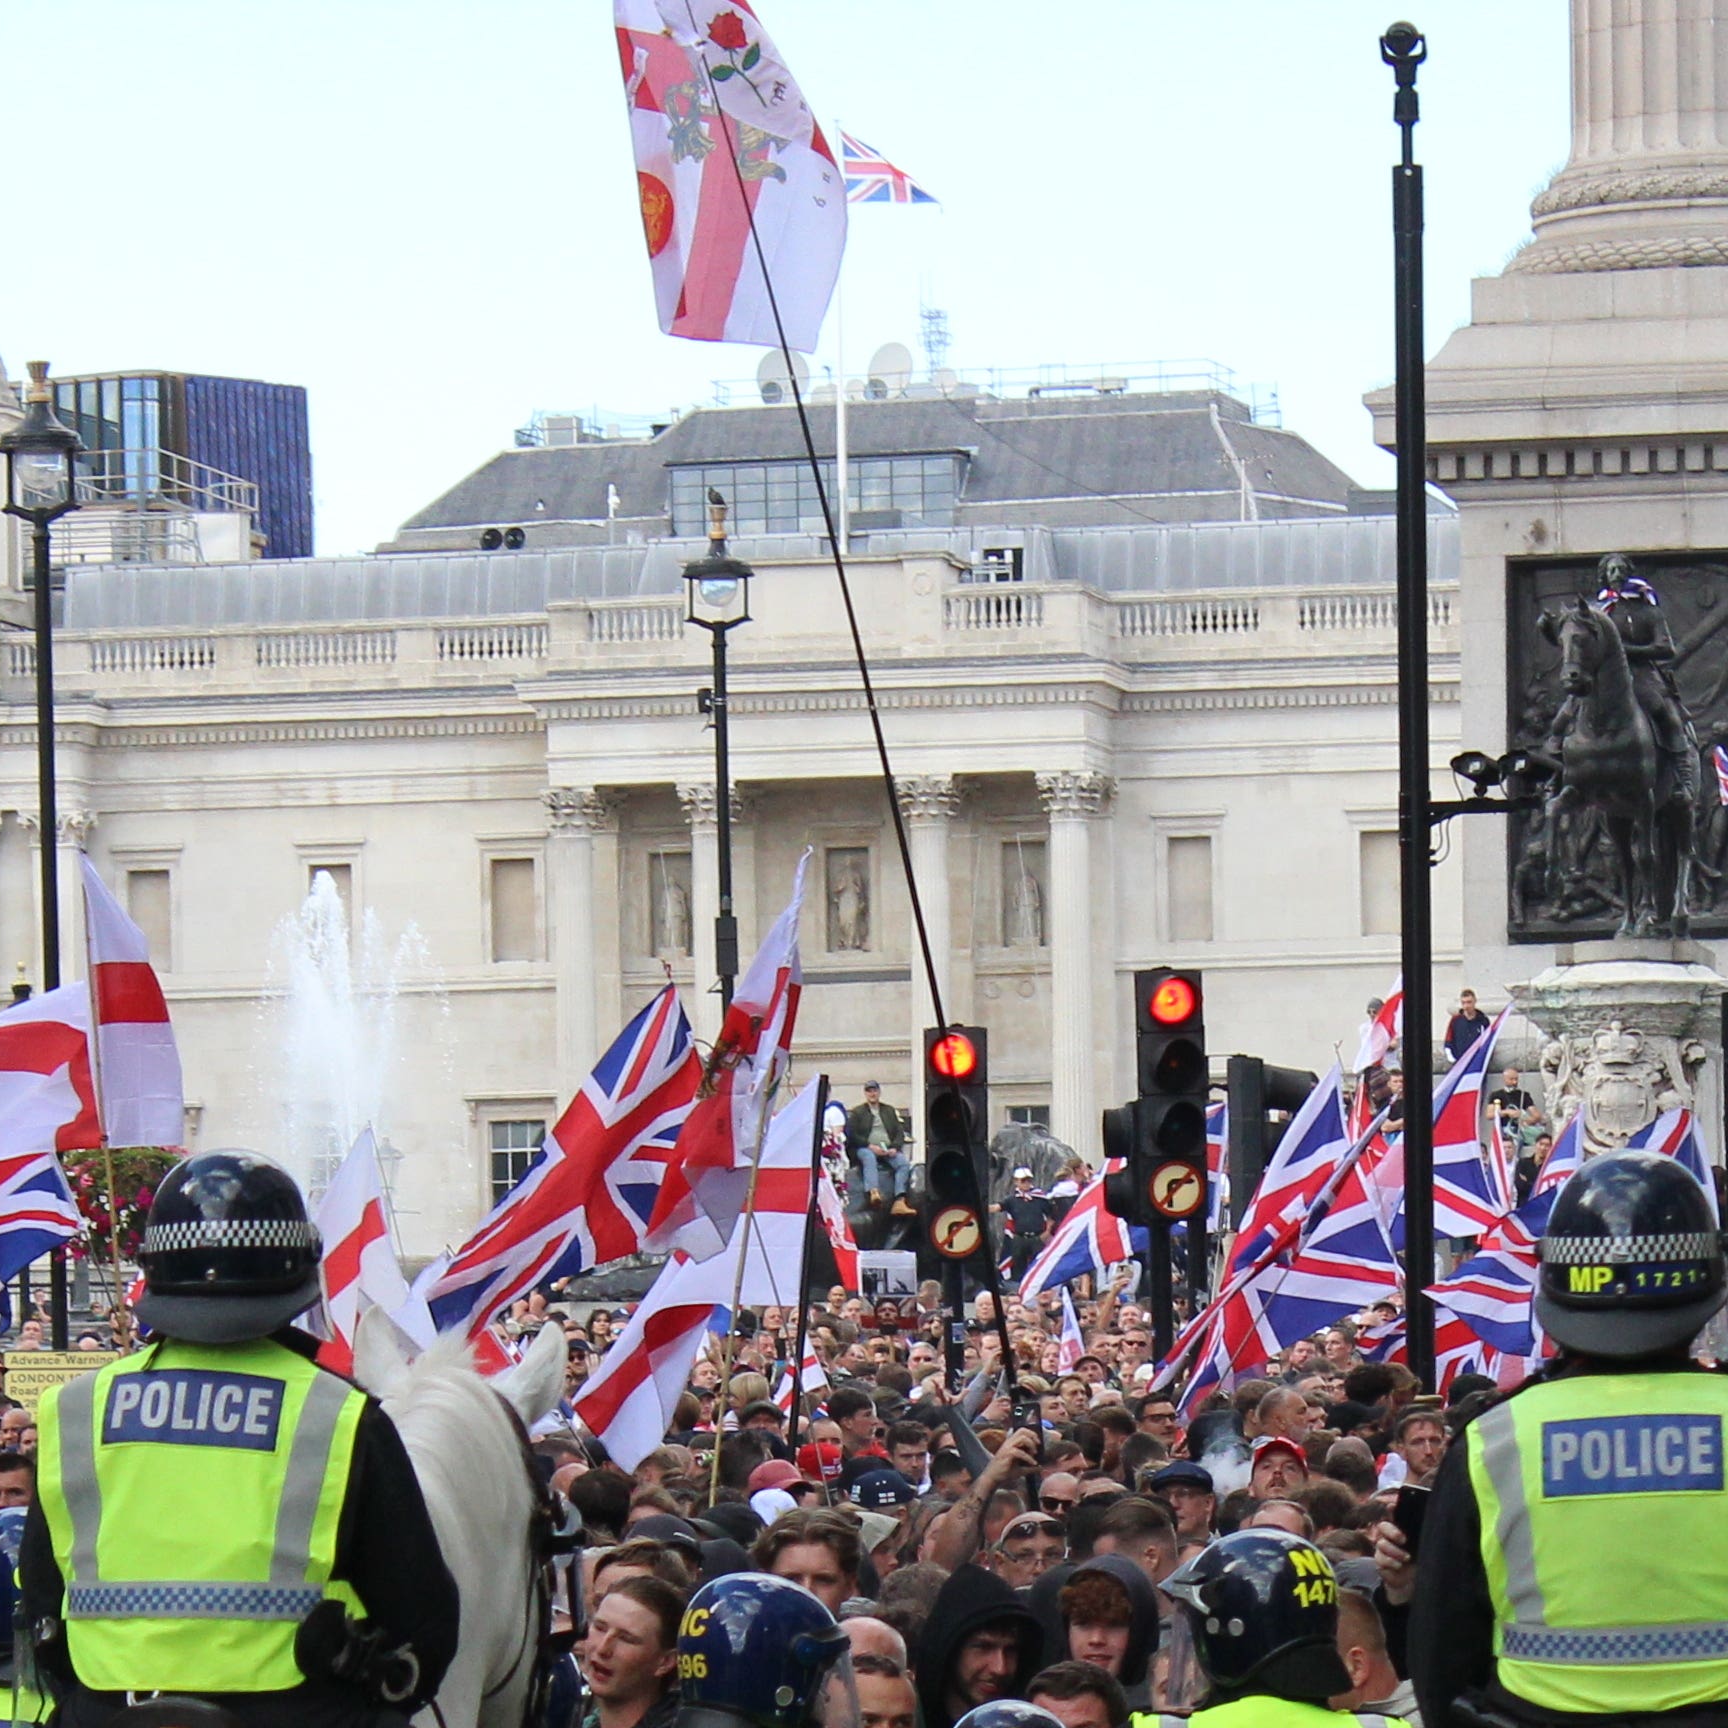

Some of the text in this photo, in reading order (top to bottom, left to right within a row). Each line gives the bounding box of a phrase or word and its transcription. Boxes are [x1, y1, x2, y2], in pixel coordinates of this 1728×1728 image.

[1569, 1266, 1697, 1293] MP 1721
[10, 1355, 60, 1365] Advance
[10, 1374, 65, 1383] LONDON
[10, 1387, 38, 1396] Road
[110, 1378, 275, 1437] POLICE
[1549, 1426, 1717, 1482] POLICE
